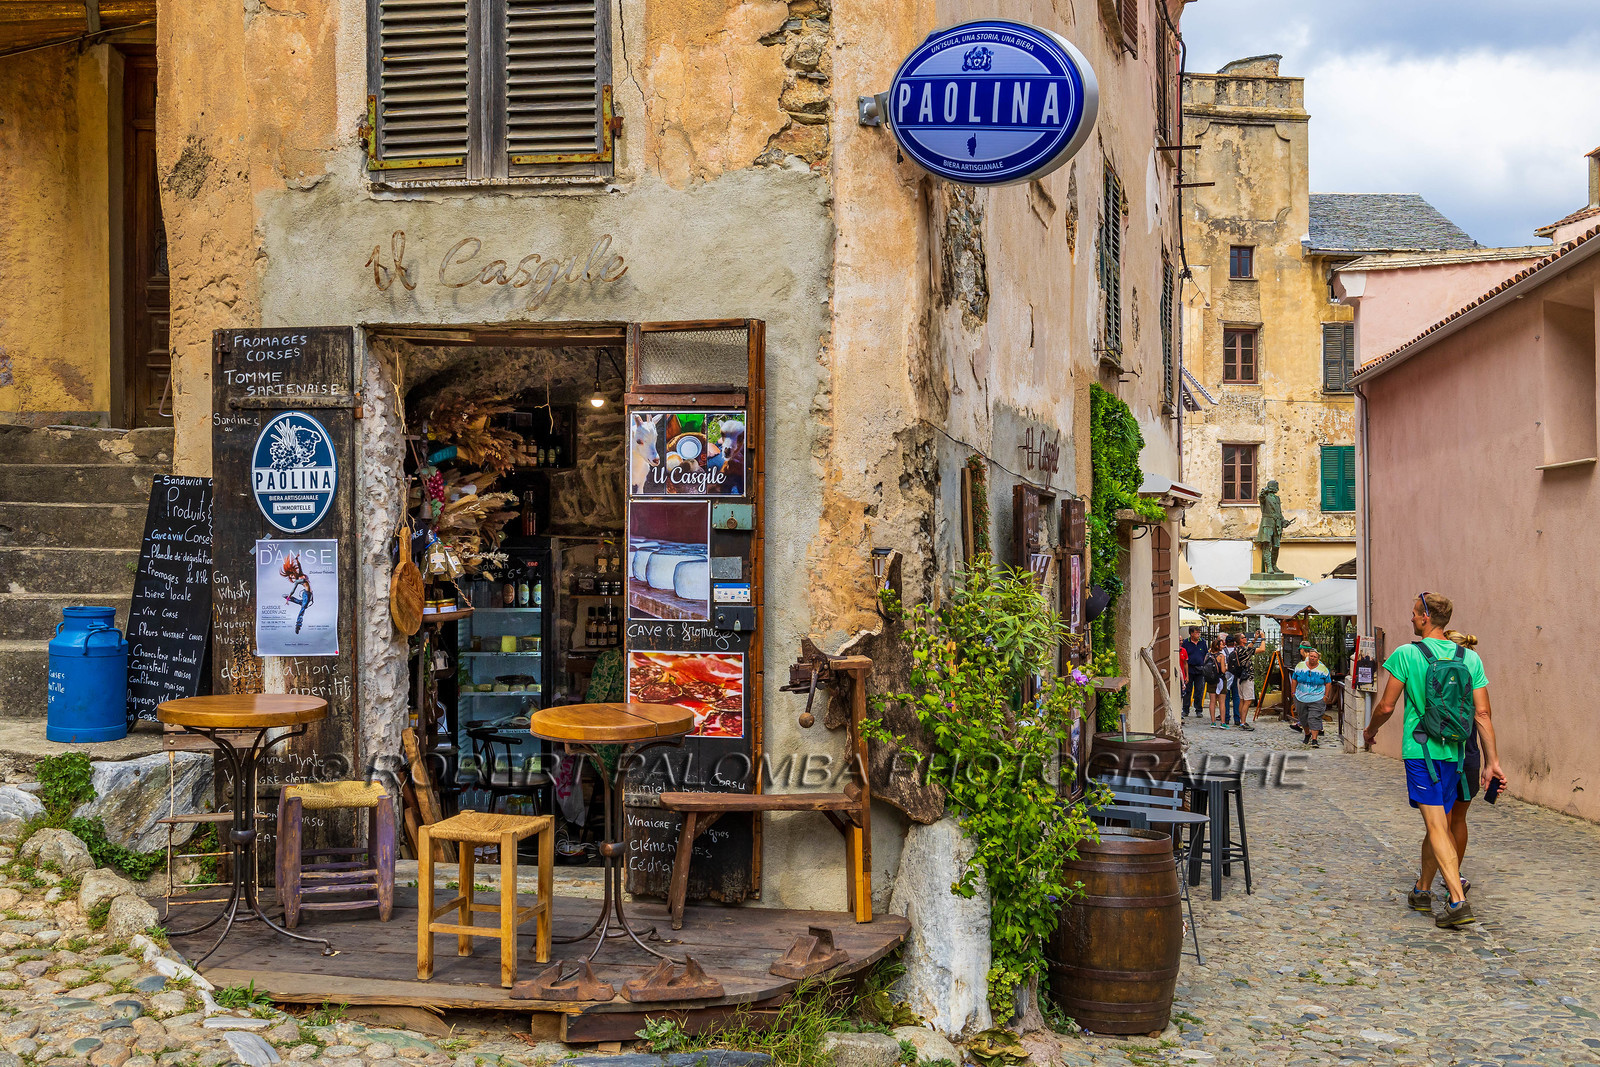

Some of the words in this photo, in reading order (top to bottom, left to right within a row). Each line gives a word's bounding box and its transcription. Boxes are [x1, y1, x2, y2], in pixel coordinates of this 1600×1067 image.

[962, 34, 975, 43] UNA
[976, 33, 1000, 43] STORIA,
[1001, 35, 1015, 44] UNA
[1015, 37, 1034, 52] BIERA
[898, 81, 1060, 125] PAOLINA
[943, 159, 960, 170] BIERA
[960, 160, 1004, 171] ARTISGIANALE
[438, 233, 629, 312] Casgile
[233, 334, 308, 348] FROMAGES
[246, 347, 301, 362] CORSES
[223, 369, 283, 385] TOMME
[212, 412, 260, 427] Sardines
[163, 475, 203, 487] Sandwich
[255, 470, 332, 490] PAOLINA
[651, 465, 667, 485] U
[670, 465, 726, 493] Casgile
[166, 486, 206, 523] Produits
[151, 543, 174, 561] Planche
[259, 549, 333, 566] DANSE
[212, 570, 230, 584] Gin
[170, 586, 192, 602] locale
[173, 669, 192, 681] maison
[163, 681, 185, 693] maison
